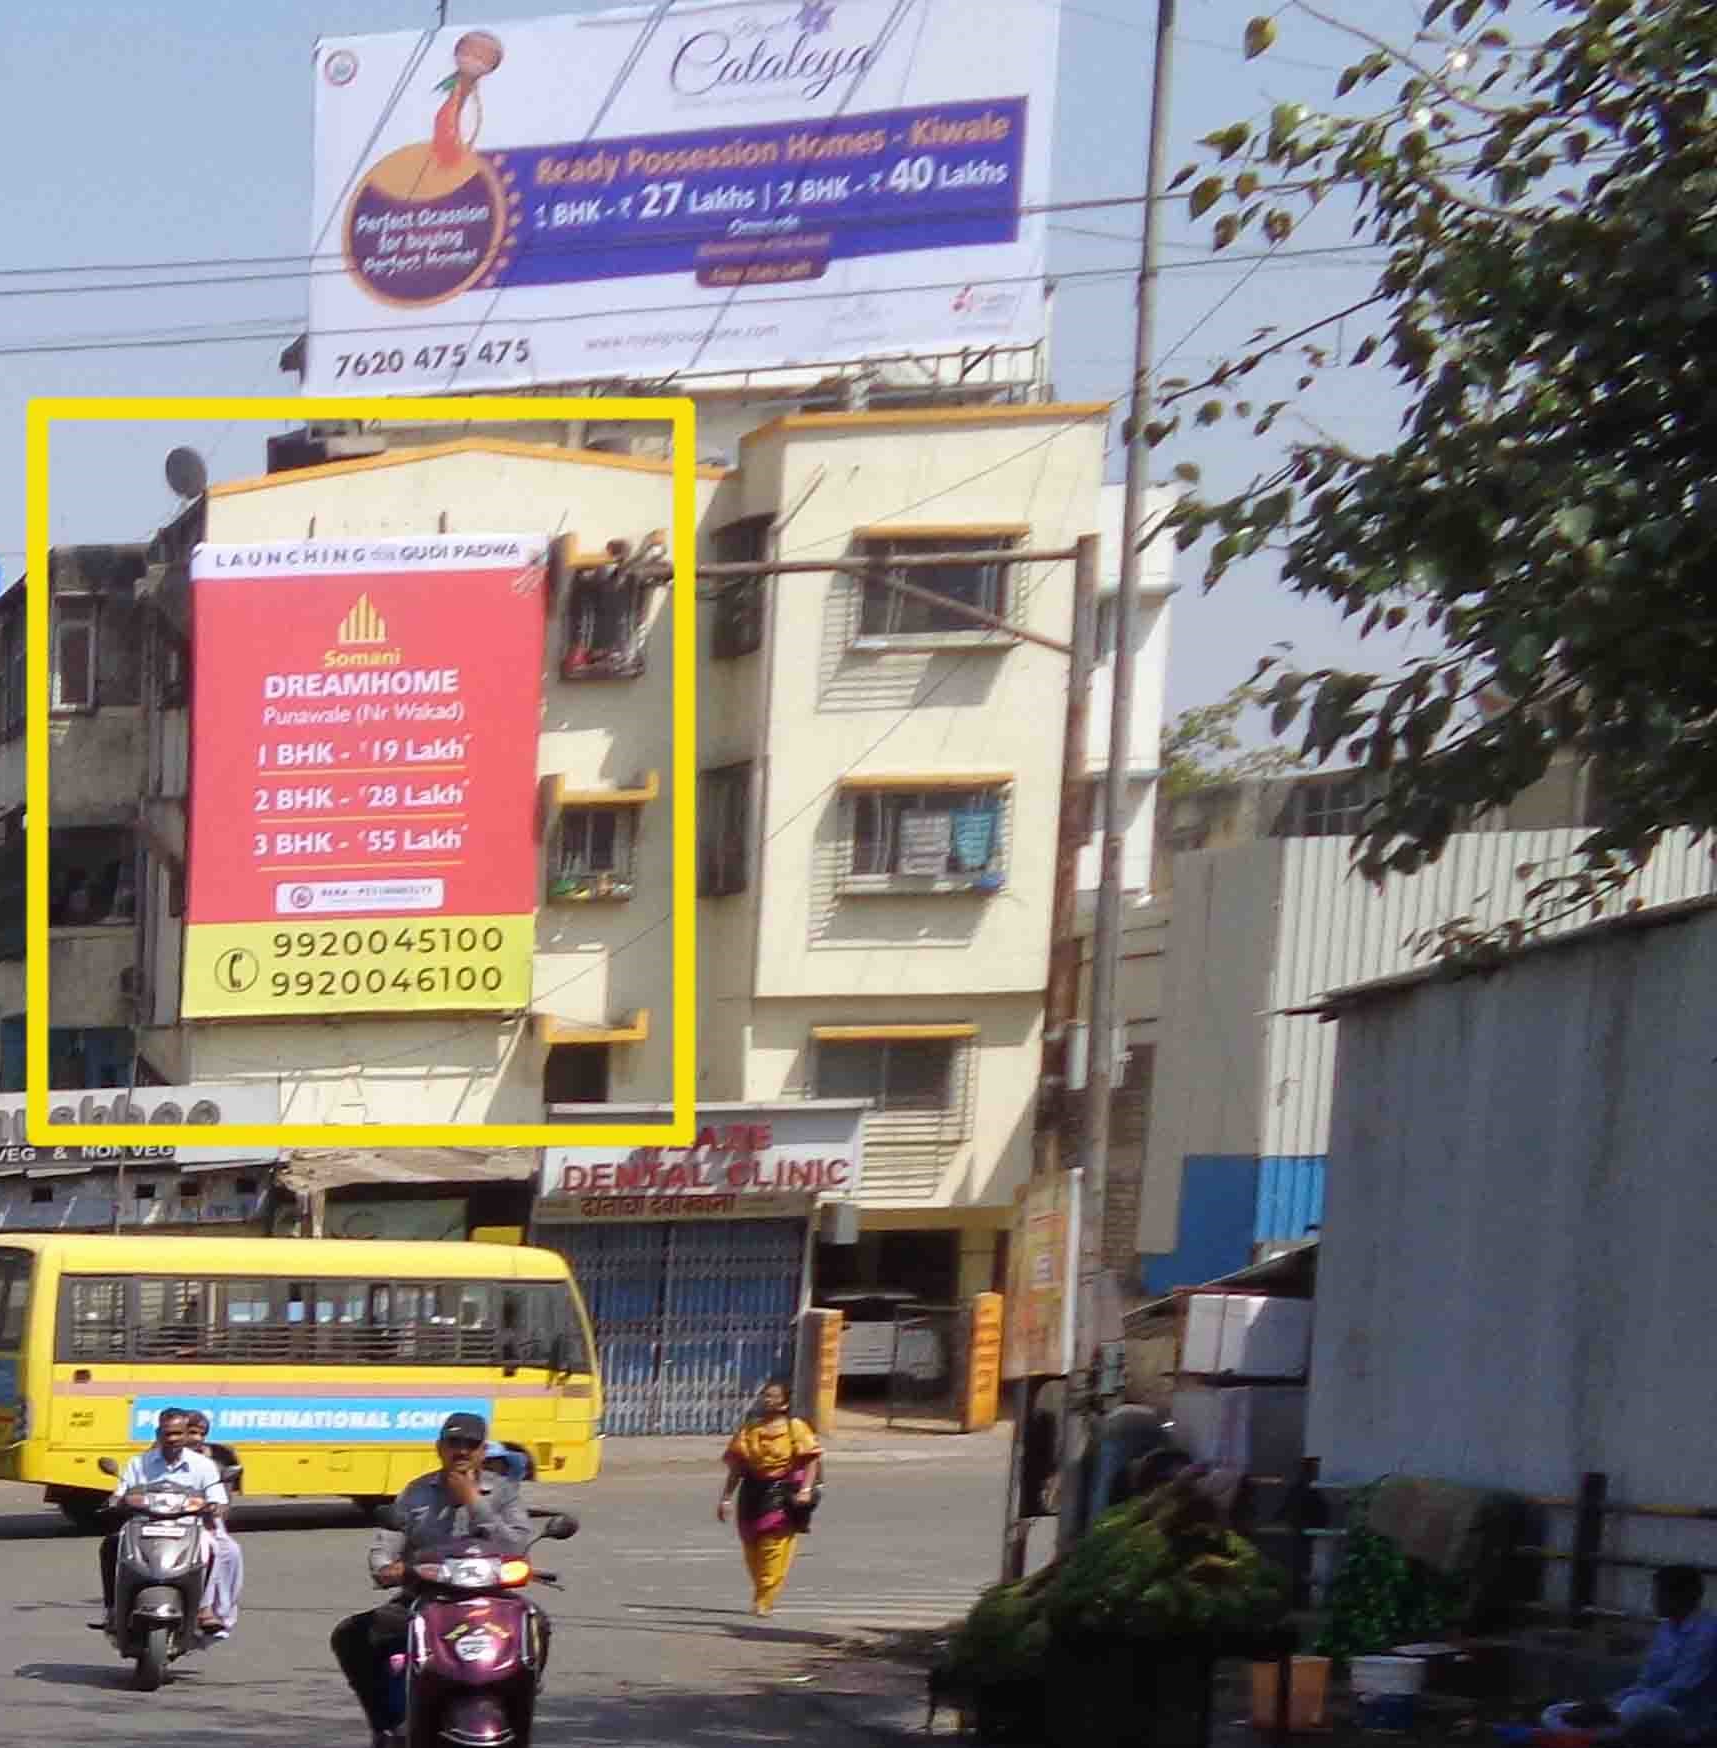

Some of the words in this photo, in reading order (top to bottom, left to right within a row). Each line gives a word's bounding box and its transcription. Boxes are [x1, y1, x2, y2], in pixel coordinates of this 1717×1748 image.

[536, 151, 621, 185] Ready
[628, 138, 778, 176] Possession
[788, 128, 886, 161] Homes
[910, 111, 1011, 146] Kiwale
[533, 202, 547, 228] 1
[551, 196, 603, 226] BHK
[639, 180, 684, 219] 27
[688, 185, 757, 213] Lakhs
[778, 181, 794, 207] 2
[797, 173, 852, 203] BHK
[887, 155, 935, 192] 40
[939, 159, 1009, 189] Lakhs
[357, 210, 415, 234] Perfect
[335, 349, 405, 379] 7620
[413, 343, 468, 370] 475
[477, 336, 531, 363] 475
[215, 546, 367, 568] LAUNCHING
[400, 545, 448, 561] GUDI
[452, 542, 520, 560] PADWA
[323, 648, 402, 668] Somani
[263, 669, 460, 699] DREAMHOME
[262, 704, 350, 726] Punawale
[356, 703, 389, 727] (Nr
[393, 701, 466, 725] Wakad)
[276, 742, 334, 766] BHK
[254, 788, 270, 812] 2
[276, 786, 334, 810] BHK
[253, 833, 269, 857] 3
[275, 832, 334, 856] BHK
[273, 927, 504, 958] 9920045100
[271, 966, 503, 997] 9920046100
[52, 1145, 70, 1160] &
[560, 1161, 711, 1193] DENTAL
[726, 1158, 851, 1188] CLINIC
[220, 1409, 391, 1430] INTERNATIONAL
